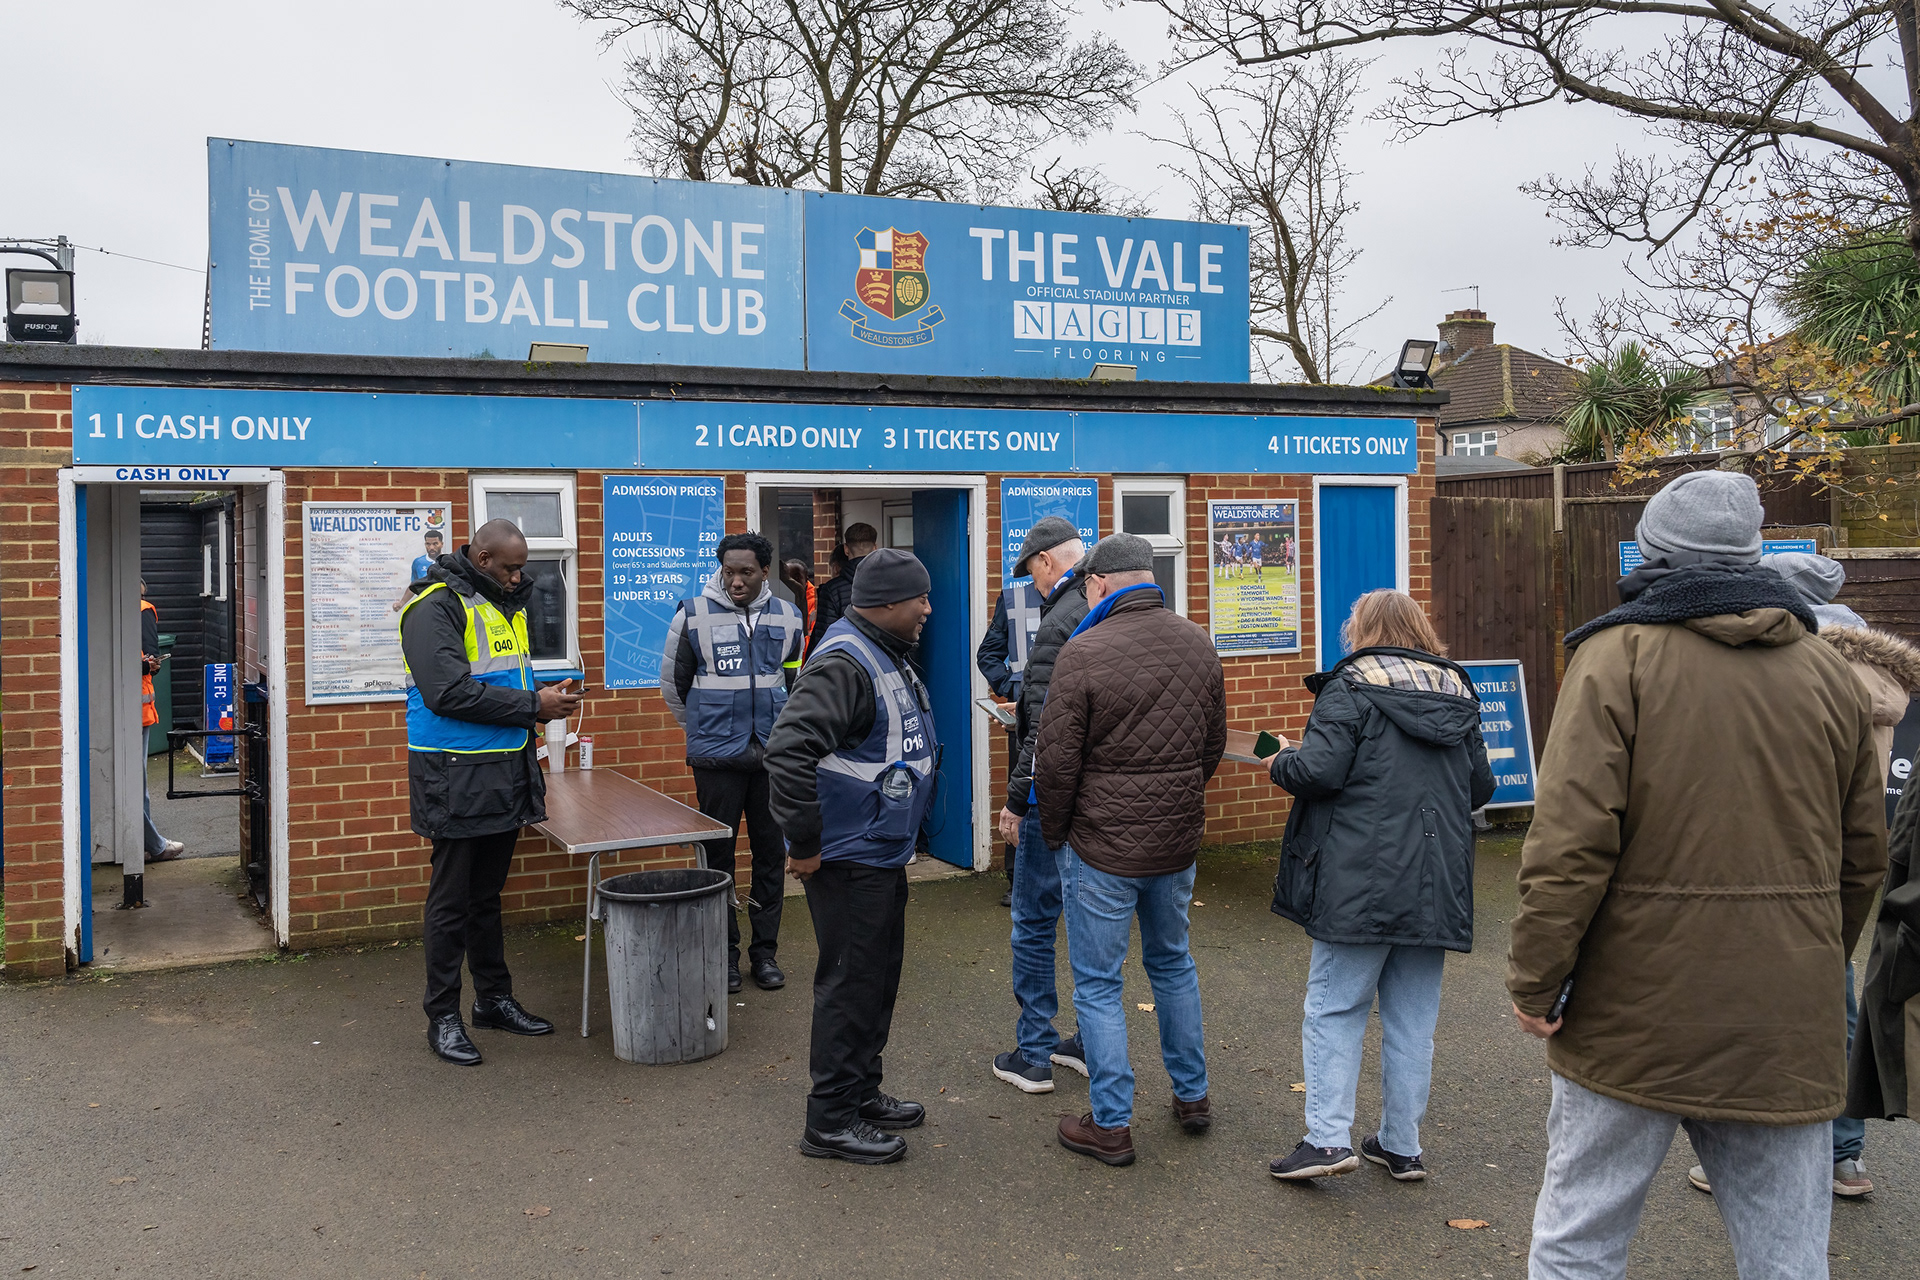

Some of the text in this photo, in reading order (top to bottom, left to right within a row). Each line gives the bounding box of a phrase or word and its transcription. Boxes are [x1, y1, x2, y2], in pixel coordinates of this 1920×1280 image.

[276, 186, 766, 280] WEALDSTONE
[248, 186, 272, 311] THE HOME OF
[969, 226, 1225, 295] THE VALE
[284, 262, 767, 336] FOOTBALL CLUB
[1026, 284, 1190, 306] OFFICIAL STADIUM PARTNER
[1018, 303, 1196, 342] NAGLE
[859, 329, 928, 345] WEALDSTONE FC
[1053, 346, 1167, 362] FLOORING
[88, 413, 106, 438] 1
[135, 414, 220, 440] CASH
[231, 416, 312, 441] ONLY
[695, 424, 709, 447] 2
[729, 425, 797, 447] CARD
[801, 427, 861, 449] ONLY
[884, 427, 896, 449] 3
[915, 428, 1000, 451] TICKETS
[1006, 431, 1060, 452] ONLY
[1267, 435, 1280, 454] 4
[1292, 436, 1361, 455] TICKETS
[1365, 437, 1409, 455] ONLY
[116, 468, 230, 481] CASH ONLY
[612, 485, 717, 496] ADMISSION PRICES
[1008, 485, 1092, 497] ADMISSION PRICES
[1213, 509, 1280, 519] WEALDSTONE FC
[310, 516, 421, 532] WEALDSTONE FC
[612, 532, 717, 542] ADULTS £20
[1008, 527, 1093, 538] ADU £20
[612, 547, 717, 558] CONCESSIONS £15
[612, 561, 630, 570] (over
[631, 561, 645, 569] 65's
[646, 561, 659, 569] and
[661, 561, 690, 569] Students
[707, 561, 718, 569] ID)
[613, 575, 626, 585] 19
[635, 574, 648, 585] 23
[650, 574, 683, 584] YEARS
[699, 573, 715, 584] £1
[613, 590, 674, 601] UNDER 19's
[494, 638, 513, 653] 040
[717, 658, 743, 671] 017
[613, 677, 660, 688] (All Cup Games
[1473, 681, 1517, 693] NSTILE 3
[214, 685, 226, 699] FC
[1479, 701, 1506, 713] ASON
[1480, 720, 1512, 732] CKETS
[903, 734, 924, 753] 016
[1503, 774, 1528, 786] ONLY
